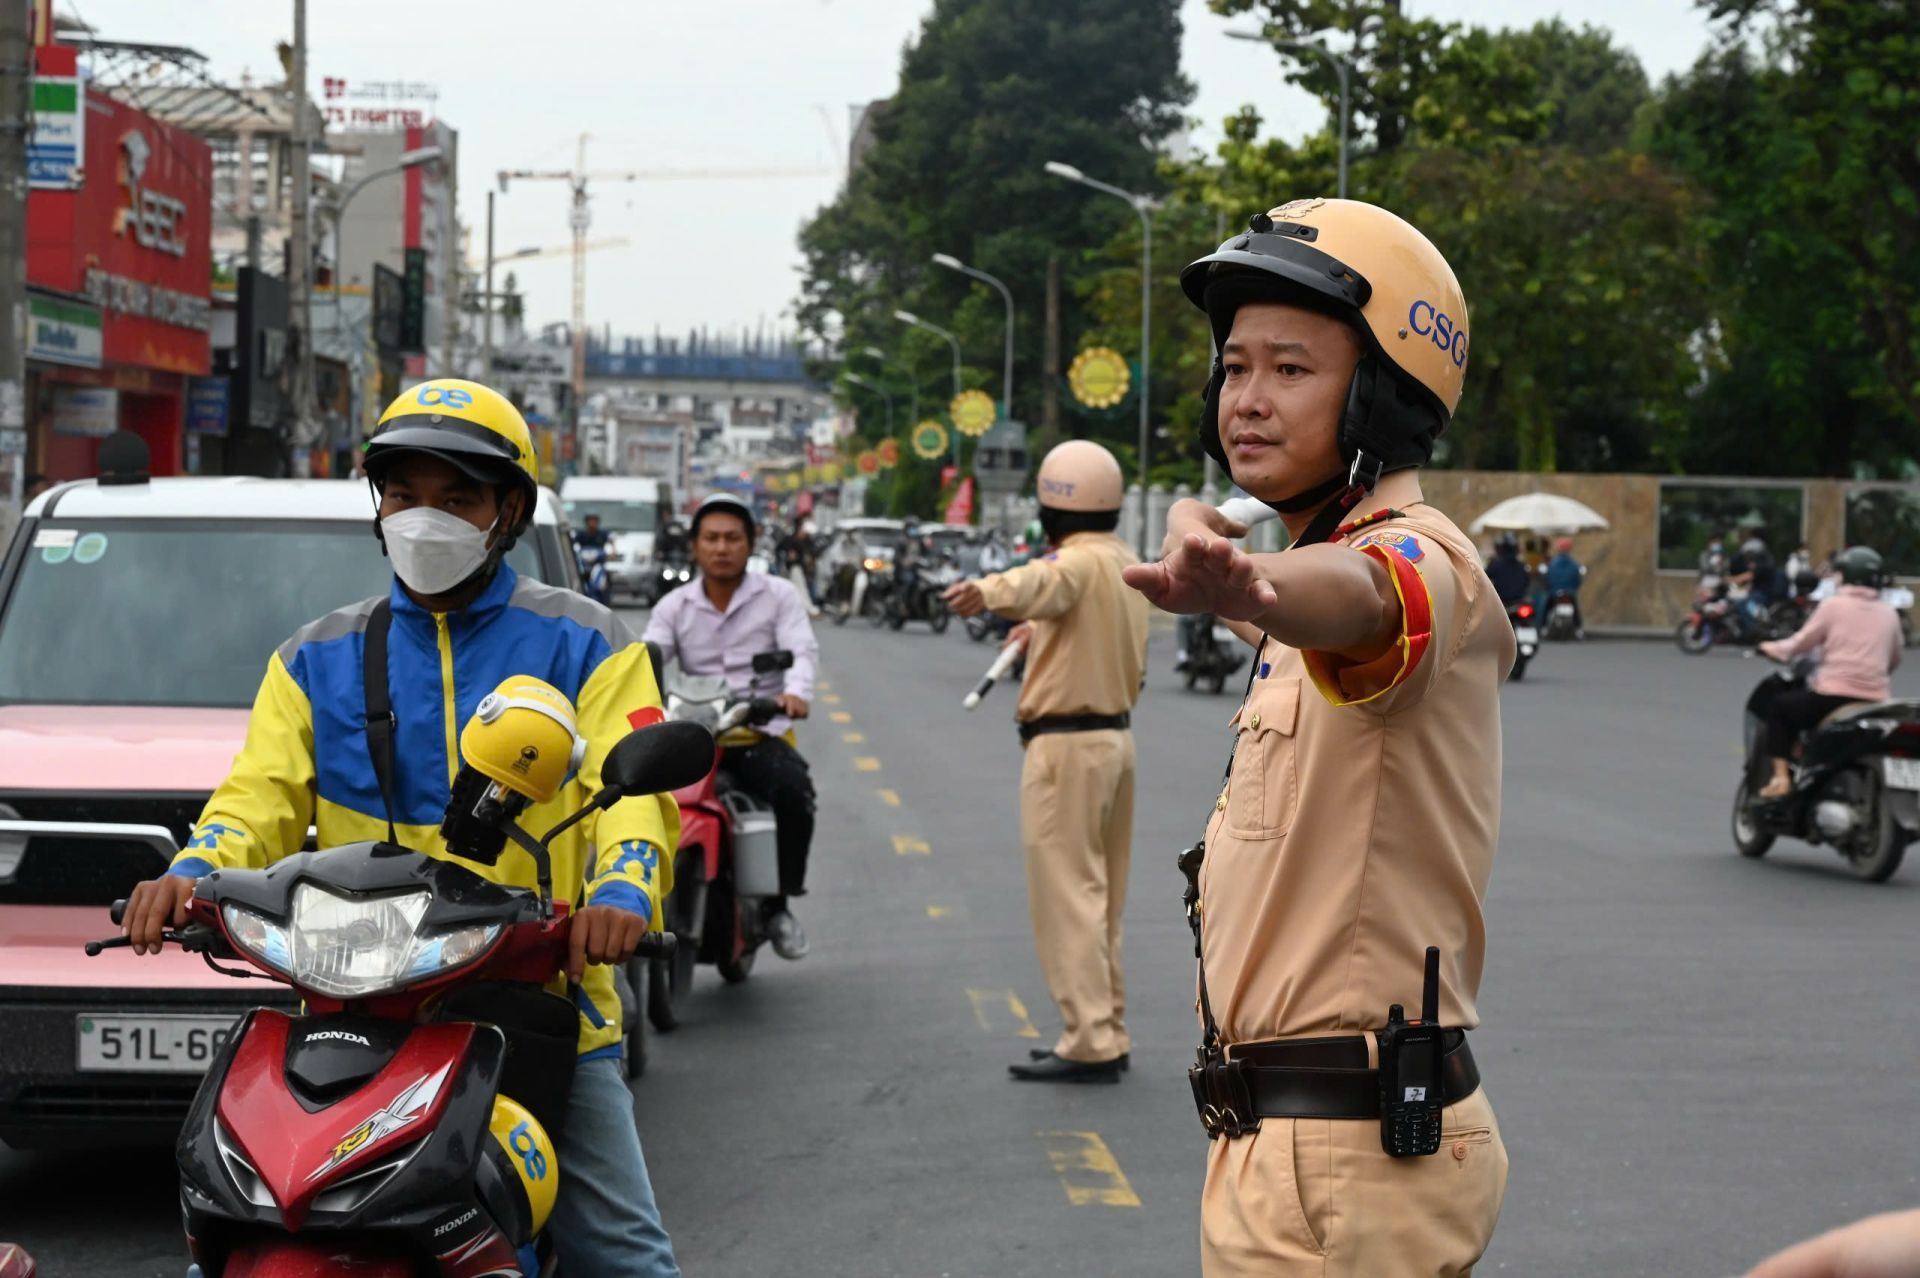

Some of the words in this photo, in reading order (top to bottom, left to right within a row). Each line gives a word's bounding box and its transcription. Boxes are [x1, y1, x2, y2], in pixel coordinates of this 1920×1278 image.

[417, 385, 472, 409] be
[305, 1031, 370, 1046] HONDA
[509, 1121, 547, 1181] be
[434, 1208, 478, 1237] HONDA
